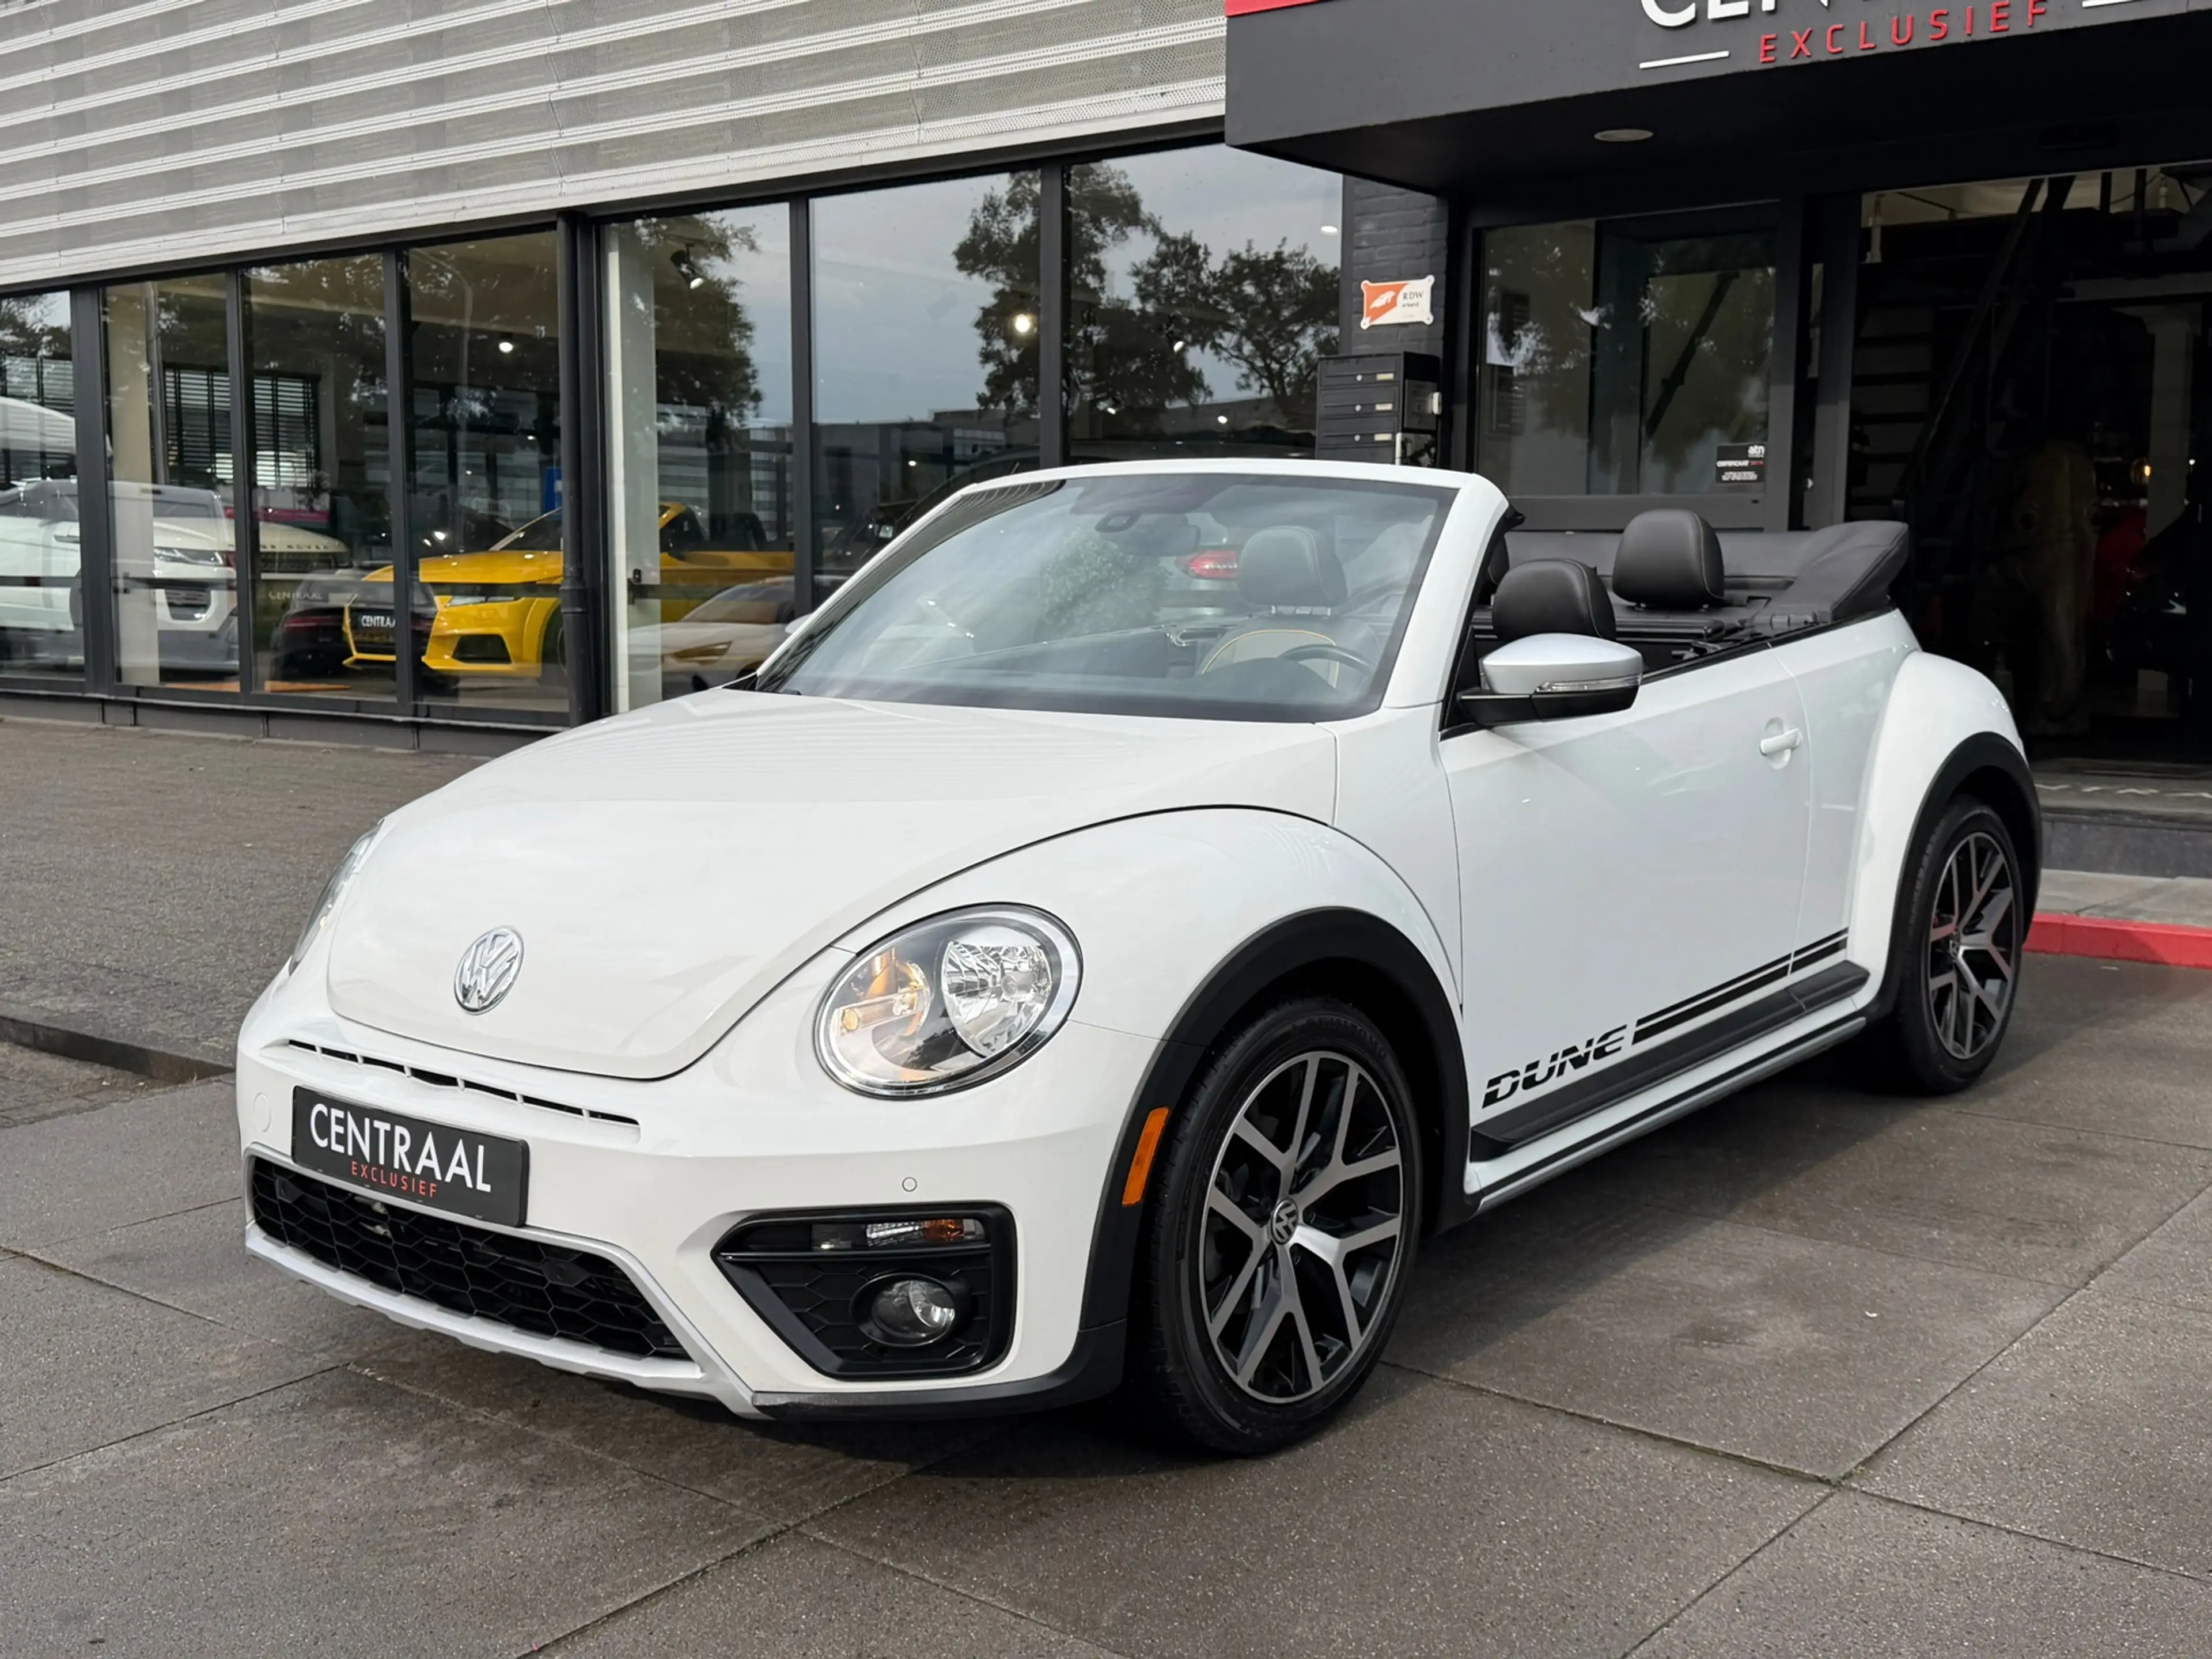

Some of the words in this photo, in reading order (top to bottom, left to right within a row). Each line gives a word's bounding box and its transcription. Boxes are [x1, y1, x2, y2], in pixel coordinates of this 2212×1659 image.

[1759, 0, 2046, 62] EXCLUSIEF
[1403, 290, 1425, 300] RDW
[1482, 1024, 1627, 1109] DUNE
[310, 1103, 491, 1193] CENTRAAL
[351, 1160, 437, 1198] EXCLUSIEF
